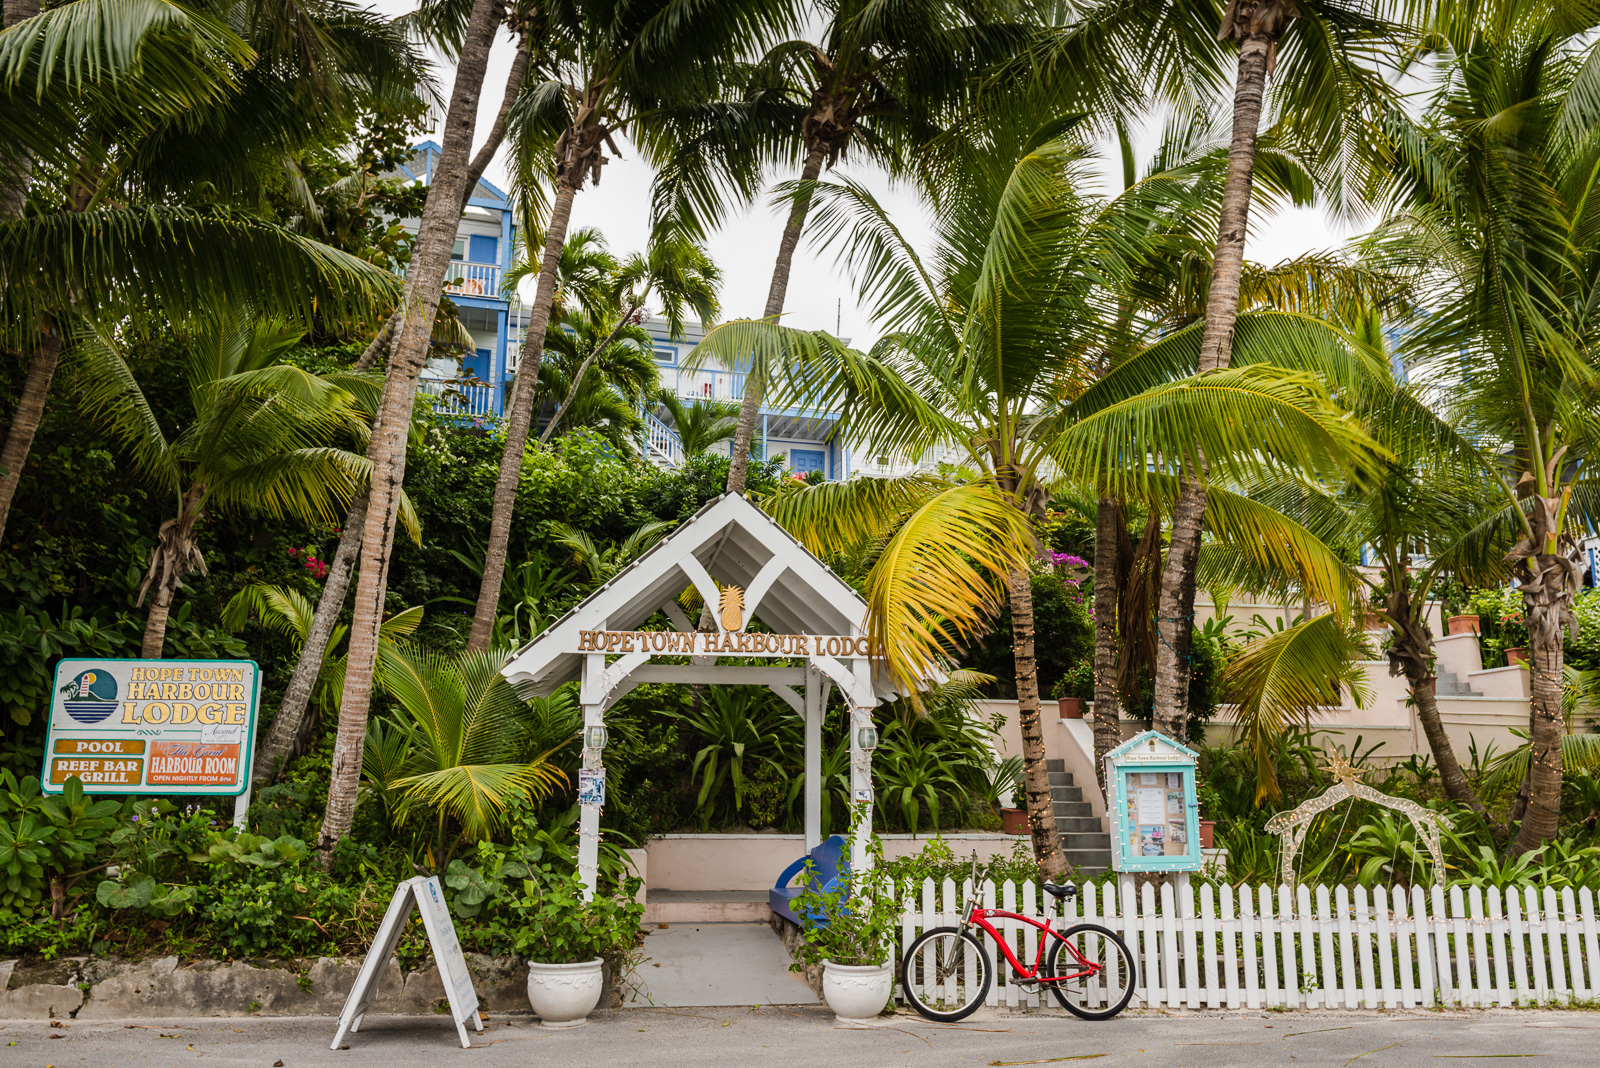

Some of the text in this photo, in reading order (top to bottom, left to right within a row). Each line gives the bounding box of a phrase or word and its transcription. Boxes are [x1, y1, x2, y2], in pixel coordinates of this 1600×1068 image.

[578, 630, 634, 652] HOPE
[636, 630, 697, 653] TOWN
[703, 632, 809, 655] HARBOUR
[131, 667, 244, 682] HOPE TOWN
[127, 682, 245, 701] HARBOUR
[121, 701, 246, 725] LODGE
[76, 742, 124, 753] POOL
[57, 760, 138, 772] REEF BAR
[150, 757, 236, 775] HARBOUR ROOM
[79, 772, 129, 783] GRILL
